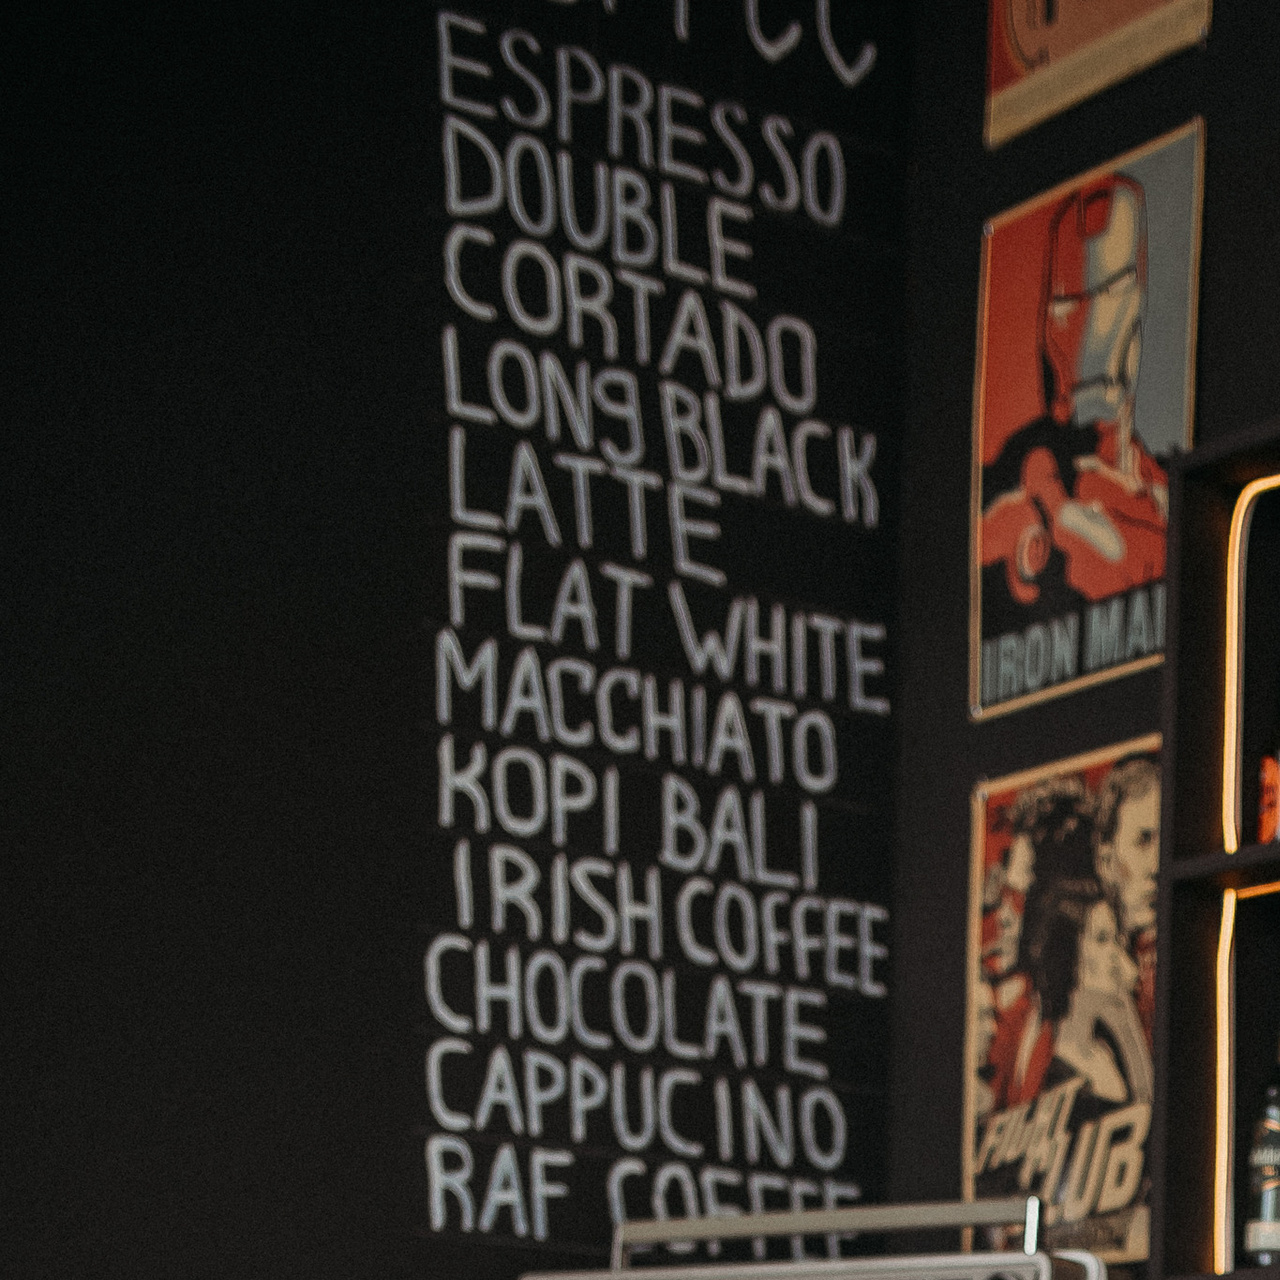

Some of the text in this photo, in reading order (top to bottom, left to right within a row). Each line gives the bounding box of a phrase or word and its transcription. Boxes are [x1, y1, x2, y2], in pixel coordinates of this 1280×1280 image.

[438, 11, 847, 226] ESPRESSO
[443, 112, 758, 299] DOUBLE
[443, 223, 818, 414] CORTADO
[451, 425, 727, 587] LATTE
[660, 380, 880, 529] BLACK
[450, 533, 891, 715] FLAT WHITE
[981, 612, 1079, 705] IRON
[435, 628, 838, 793] MACCHIATO
[437, 731, 820, 891] KOPI BALI
[454, 838, 890, 997] IRISH COFFEE
[425, 932, 829, 1080] CHOCOLATE
[425, 1039, 849, 1170] CAPPUCINO
[425, 1134, 575, 1242] RAF
